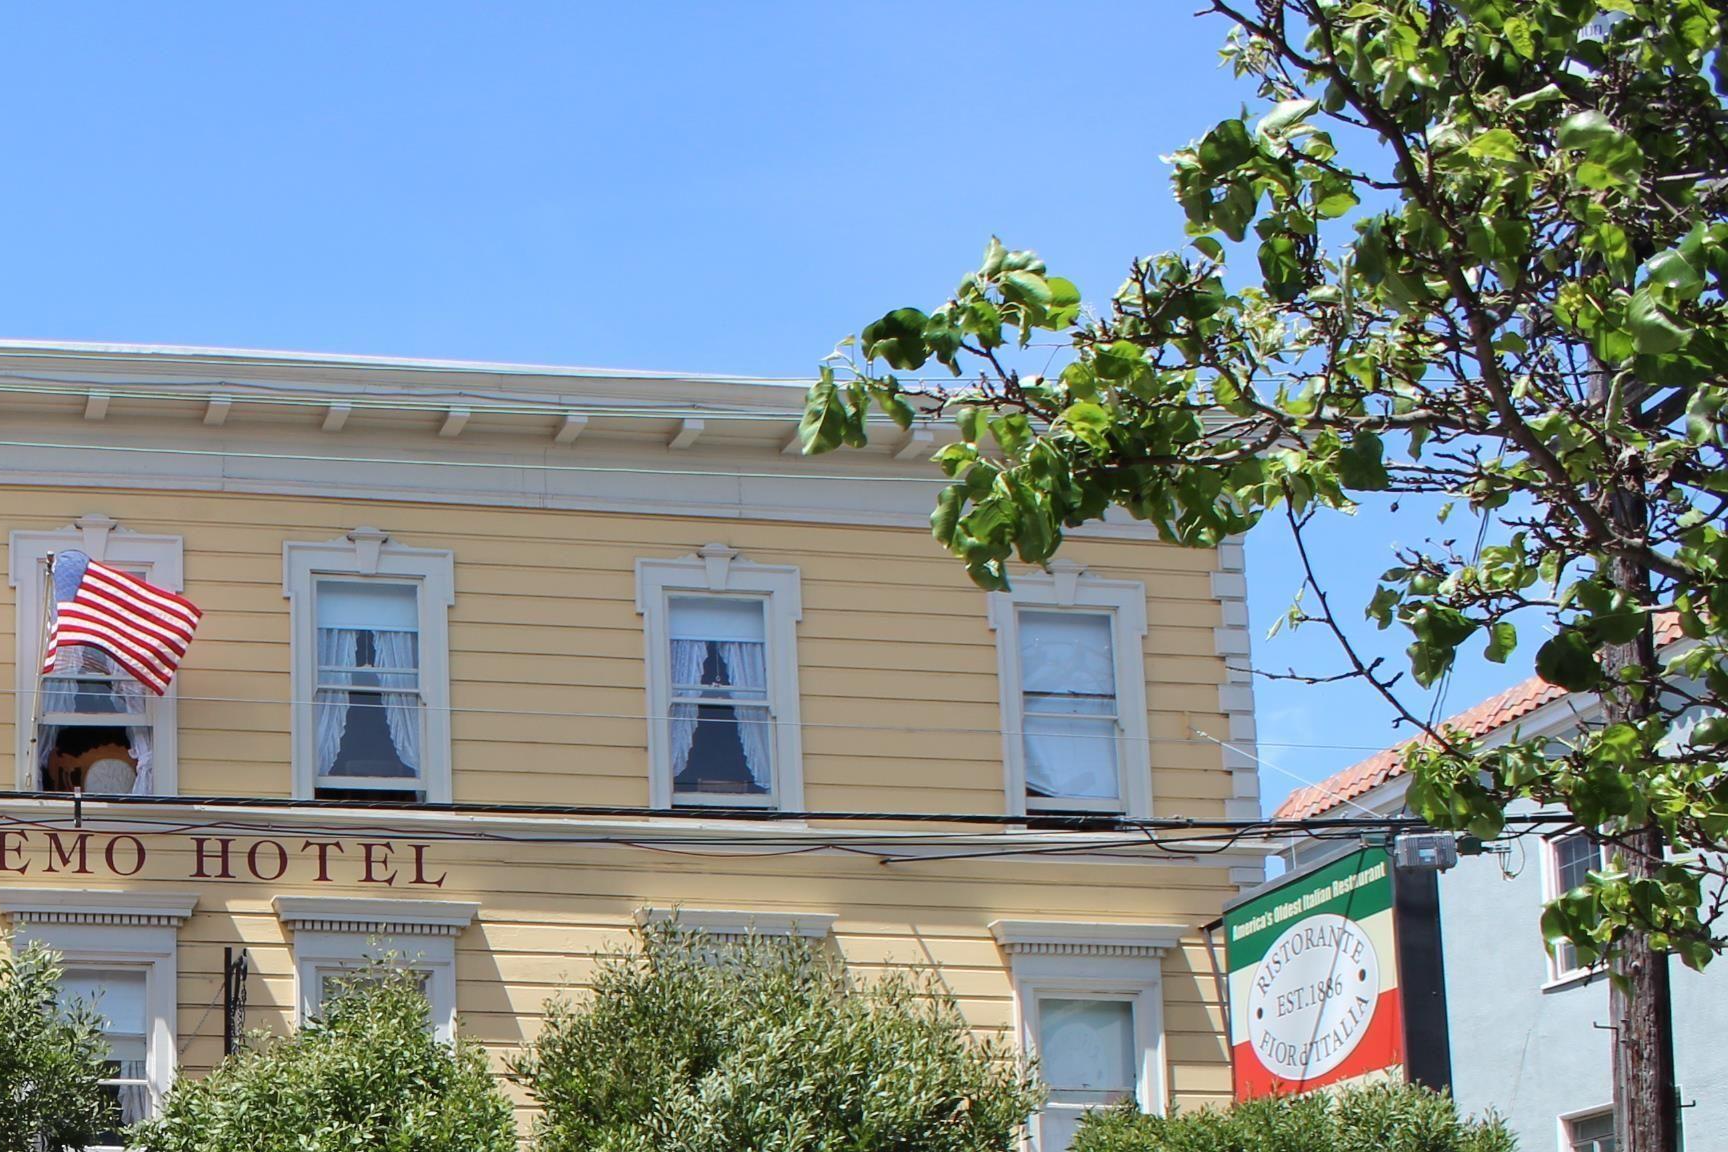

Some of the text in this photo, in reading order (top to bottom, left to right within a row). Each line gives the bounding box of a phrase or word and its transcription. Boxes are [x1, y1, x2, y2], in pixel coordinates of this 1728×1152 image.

[189, 836, 449, 888] HOTEL
[1232, 861, 1387, 943] America's Oldest Italian Restaurant
[1256, 924, 1365, 997] RISTORANTE
[1259, 1028, 1297, 1066] FIOR
